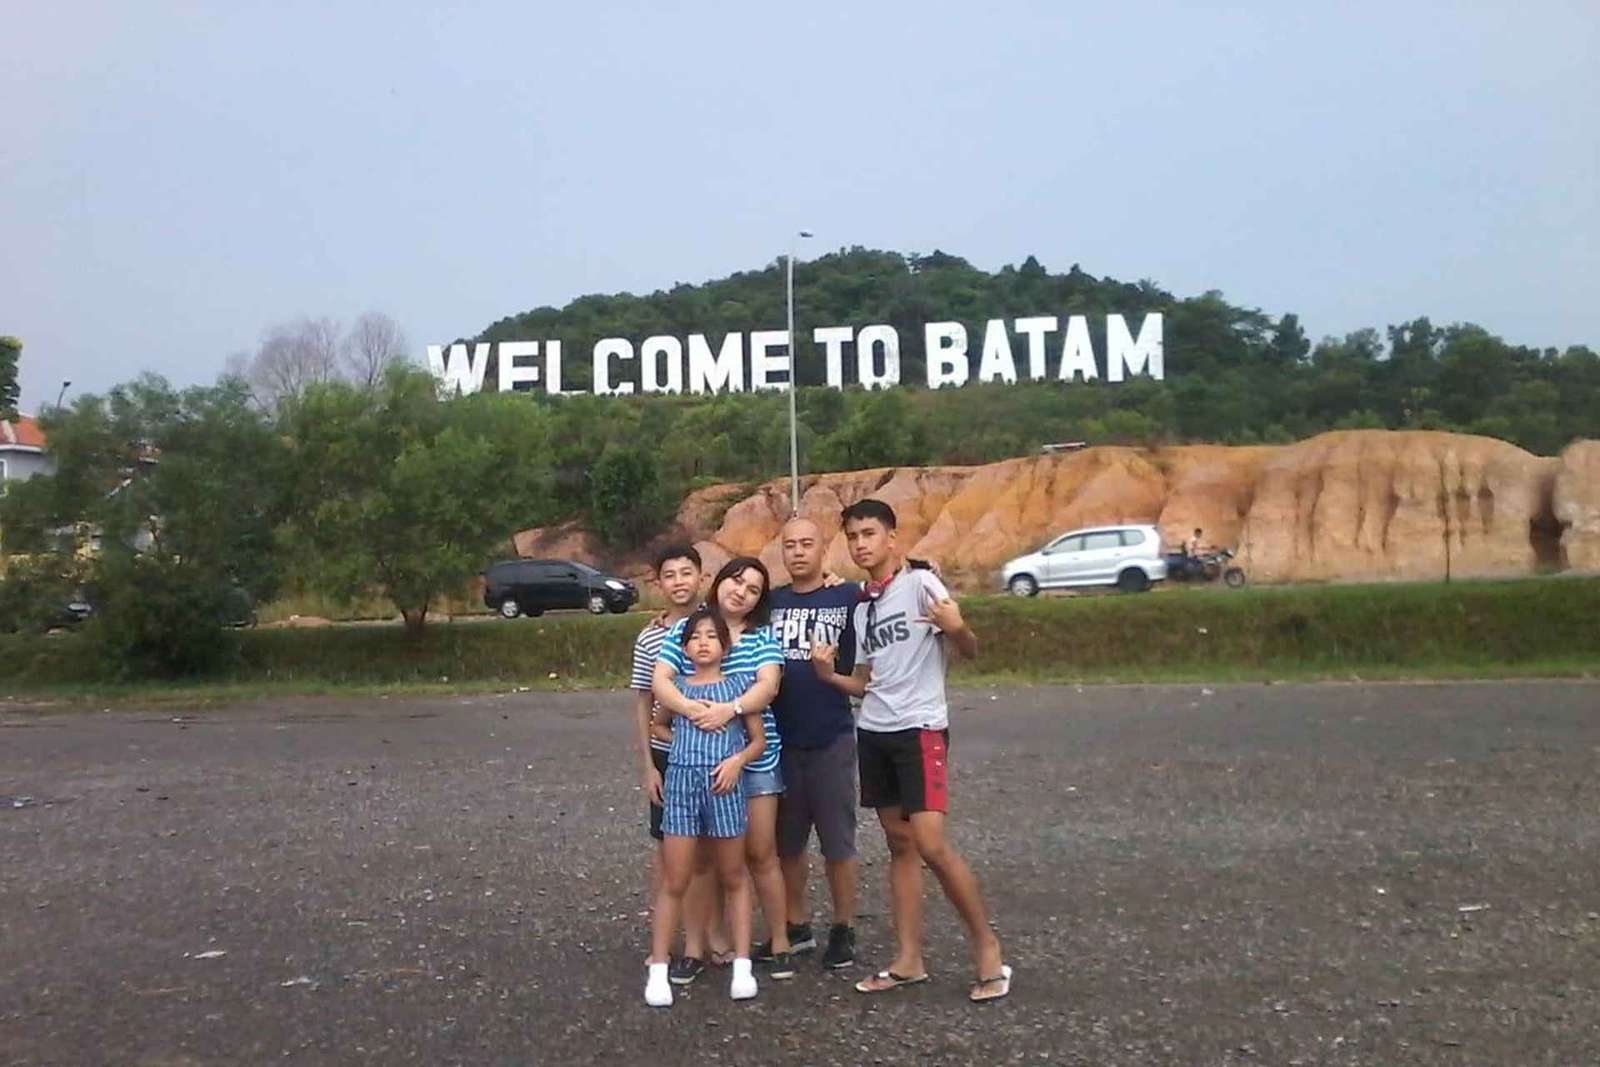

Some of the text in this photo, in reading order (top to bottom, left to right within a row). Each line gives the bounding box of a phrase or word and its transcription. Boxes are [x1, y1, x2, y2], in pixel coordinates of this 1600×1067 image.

[427, 312, 1164, 401] WELCOME TO BATAM
[786, 607, 817, 621] 1981
[772, 620, 842, 650] EPLAY
[861, 612, 910, 655] VANS
